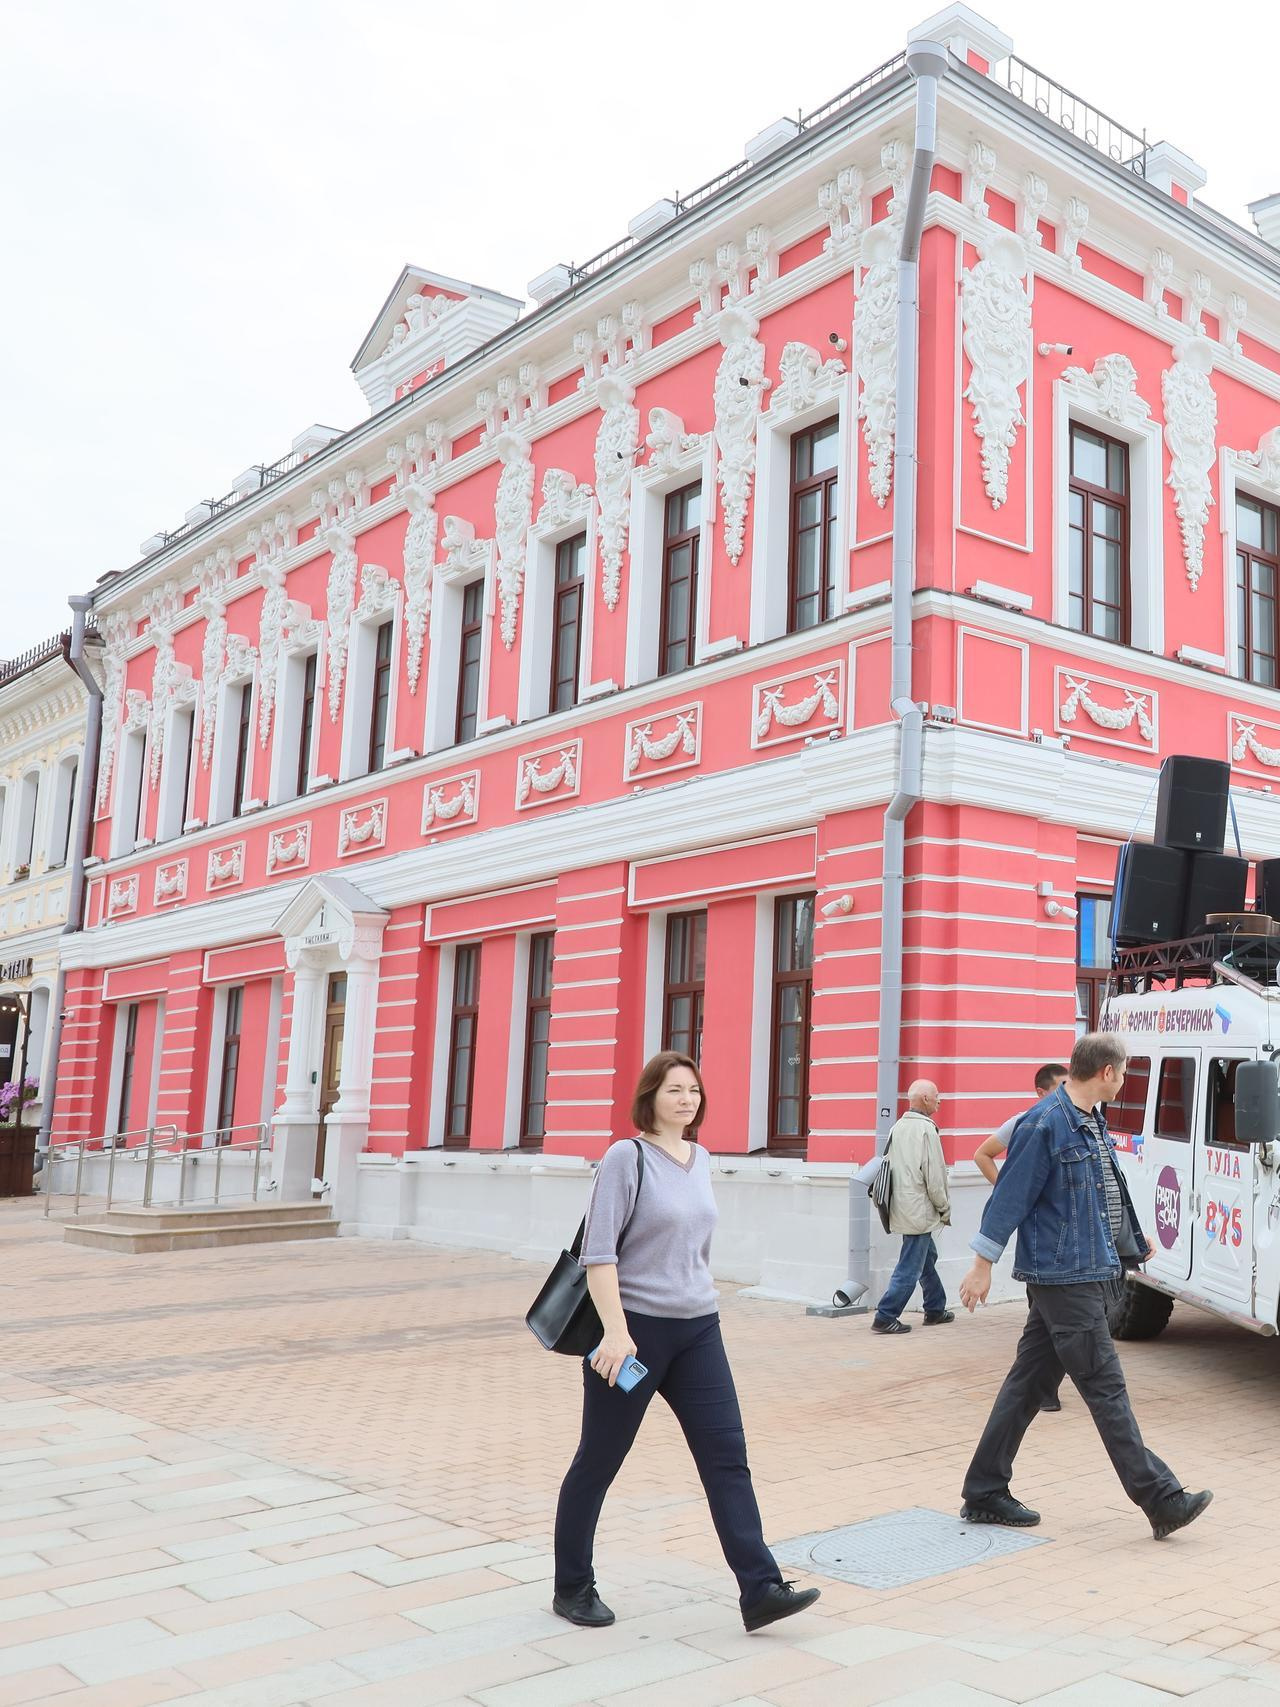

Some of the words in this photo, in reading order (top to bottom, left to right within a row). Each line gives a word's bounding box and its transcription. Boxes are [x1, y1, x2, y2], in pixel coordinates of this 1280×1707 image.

[1128, 1010, 1159, 1033] ФОРМАТ
[1165, 1008, 1214, 1033] ВЕЧЕРИНОК
[1206, 1148, 1241, 1179] ТУЛА
[1156, 1184, 1179, 1211] PARTY
[1205, 1200, 1243, 1248] 875
